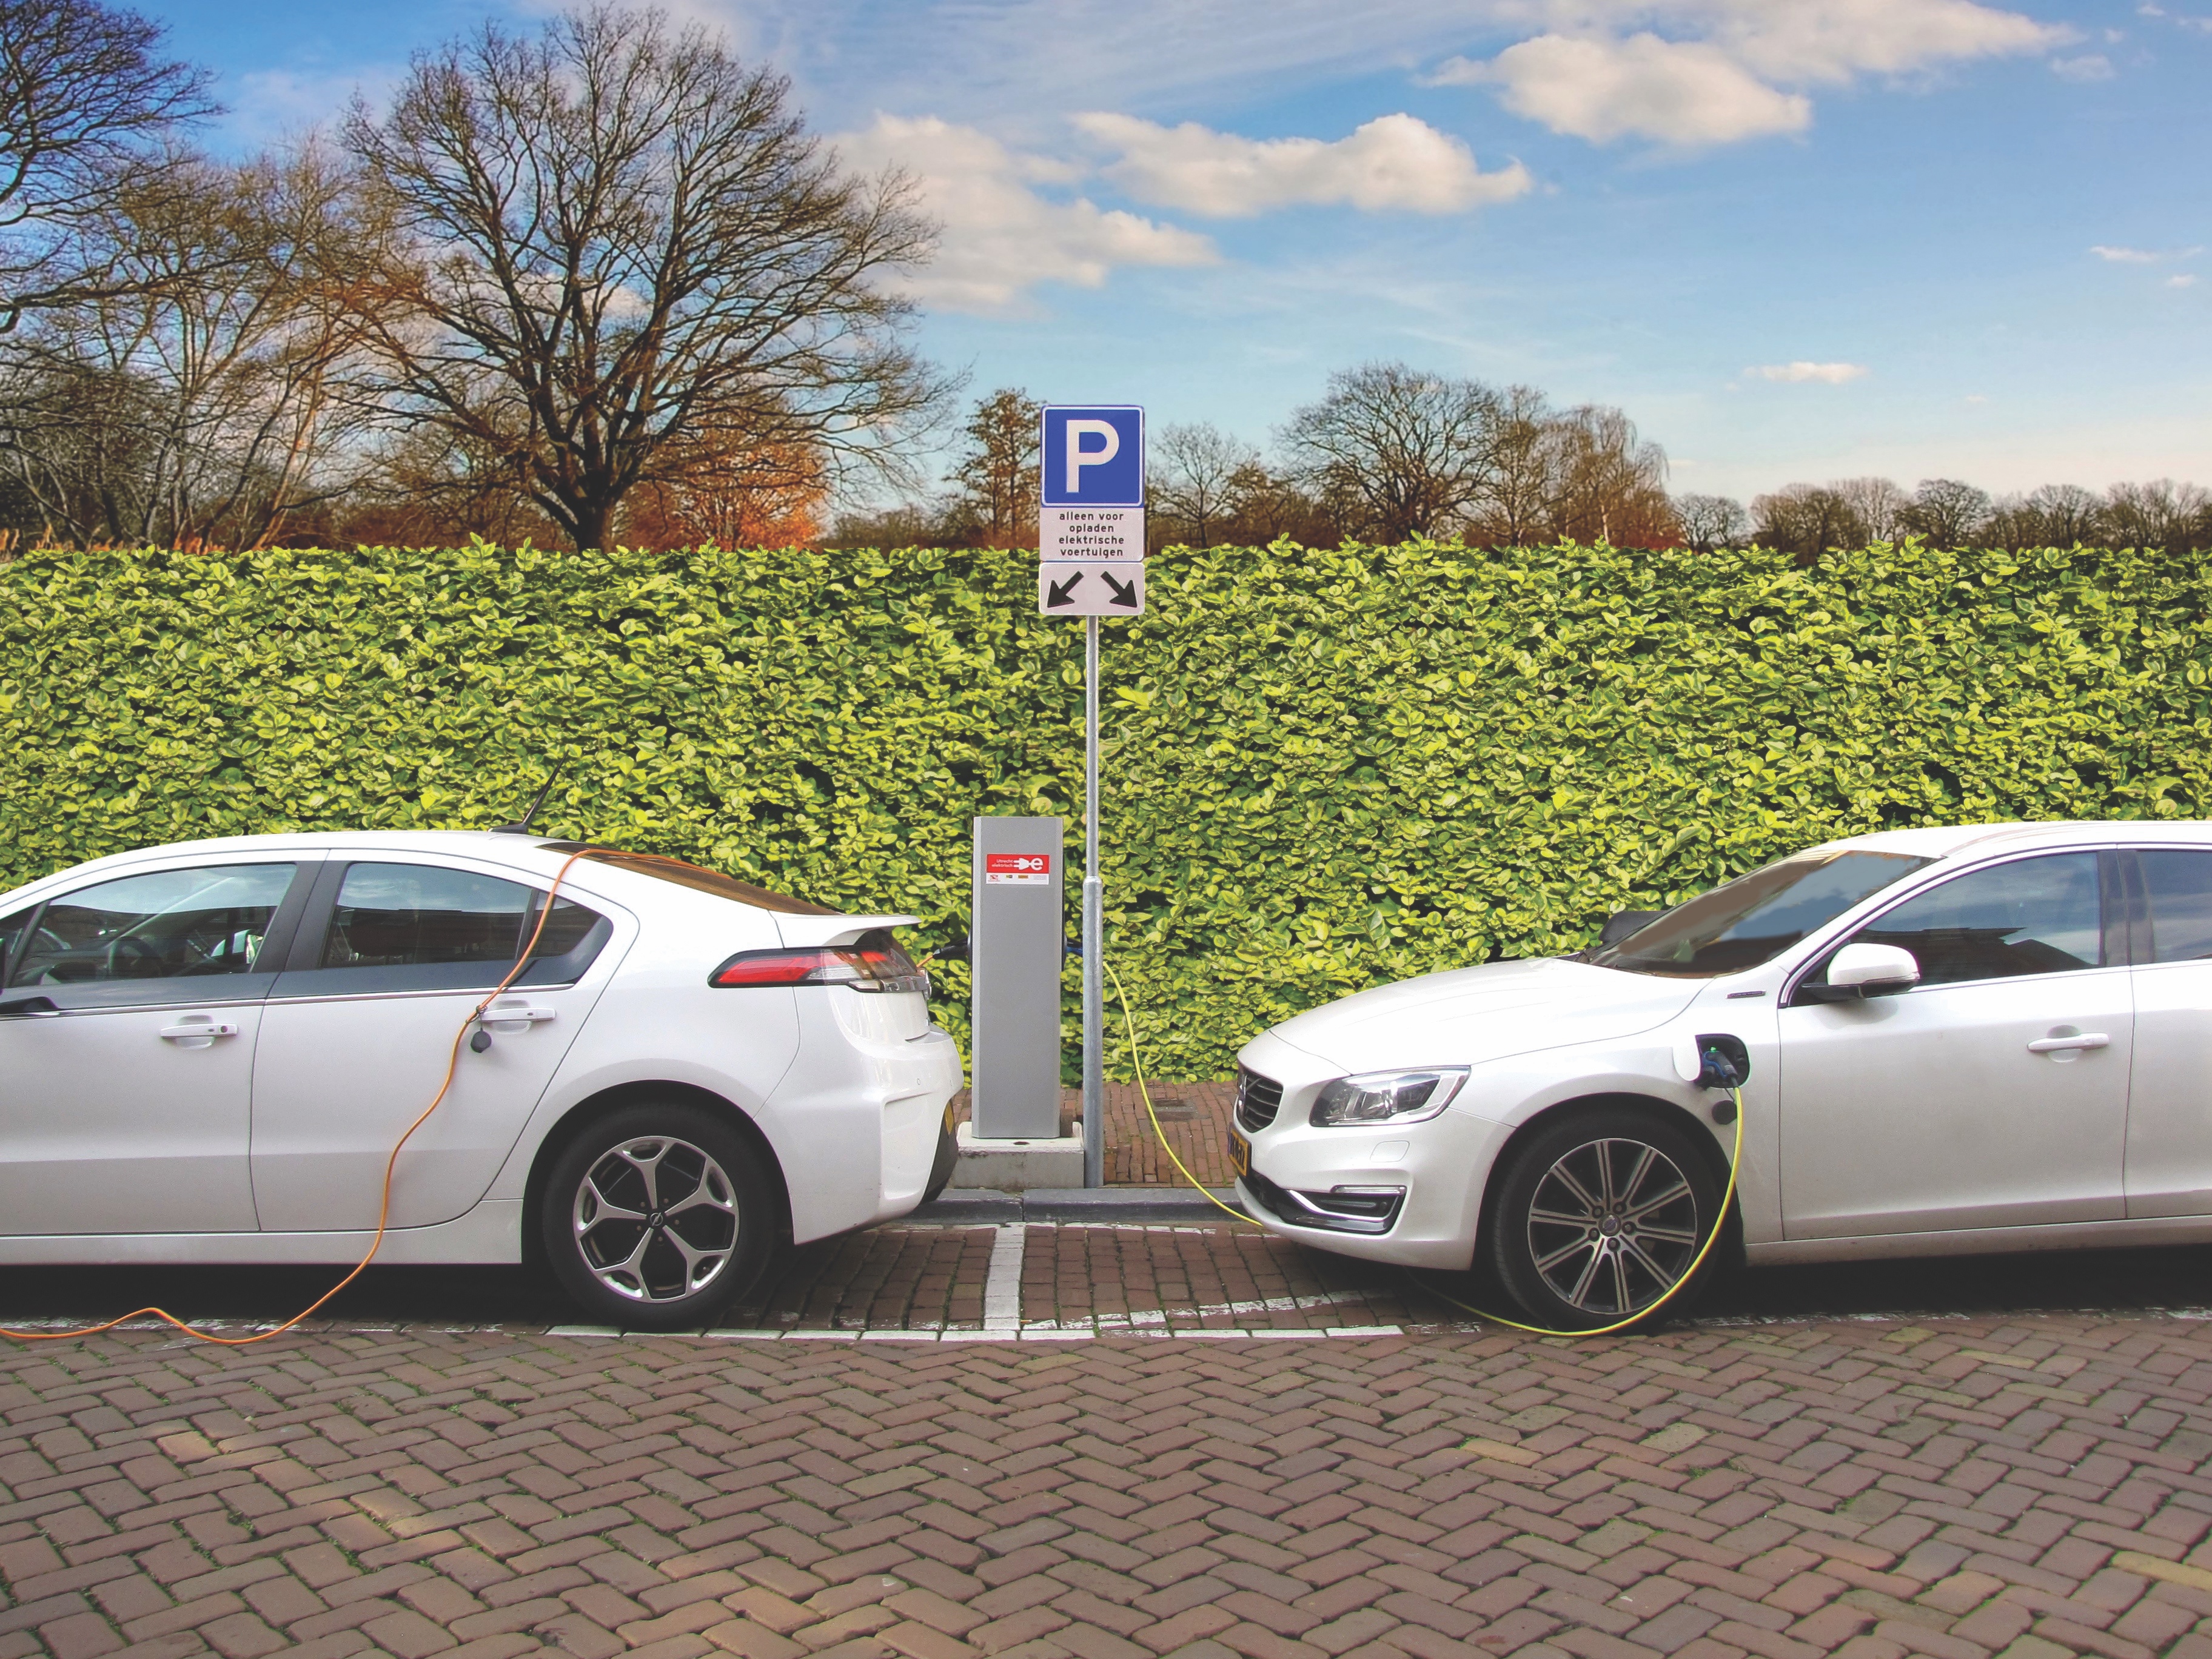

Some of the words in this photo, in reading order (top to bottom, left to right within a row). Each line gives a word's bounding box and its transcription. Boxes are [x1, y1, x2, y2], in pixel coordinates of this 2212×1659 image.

[1066, 419, 1119, 493] P
[1059, 511, 1094, 521] alleen
[1069, 523, 1114, 534] opladen
[1059, 535, 1124, 545] elektrische
[1060, 547, 1123, 559] voertuigen
